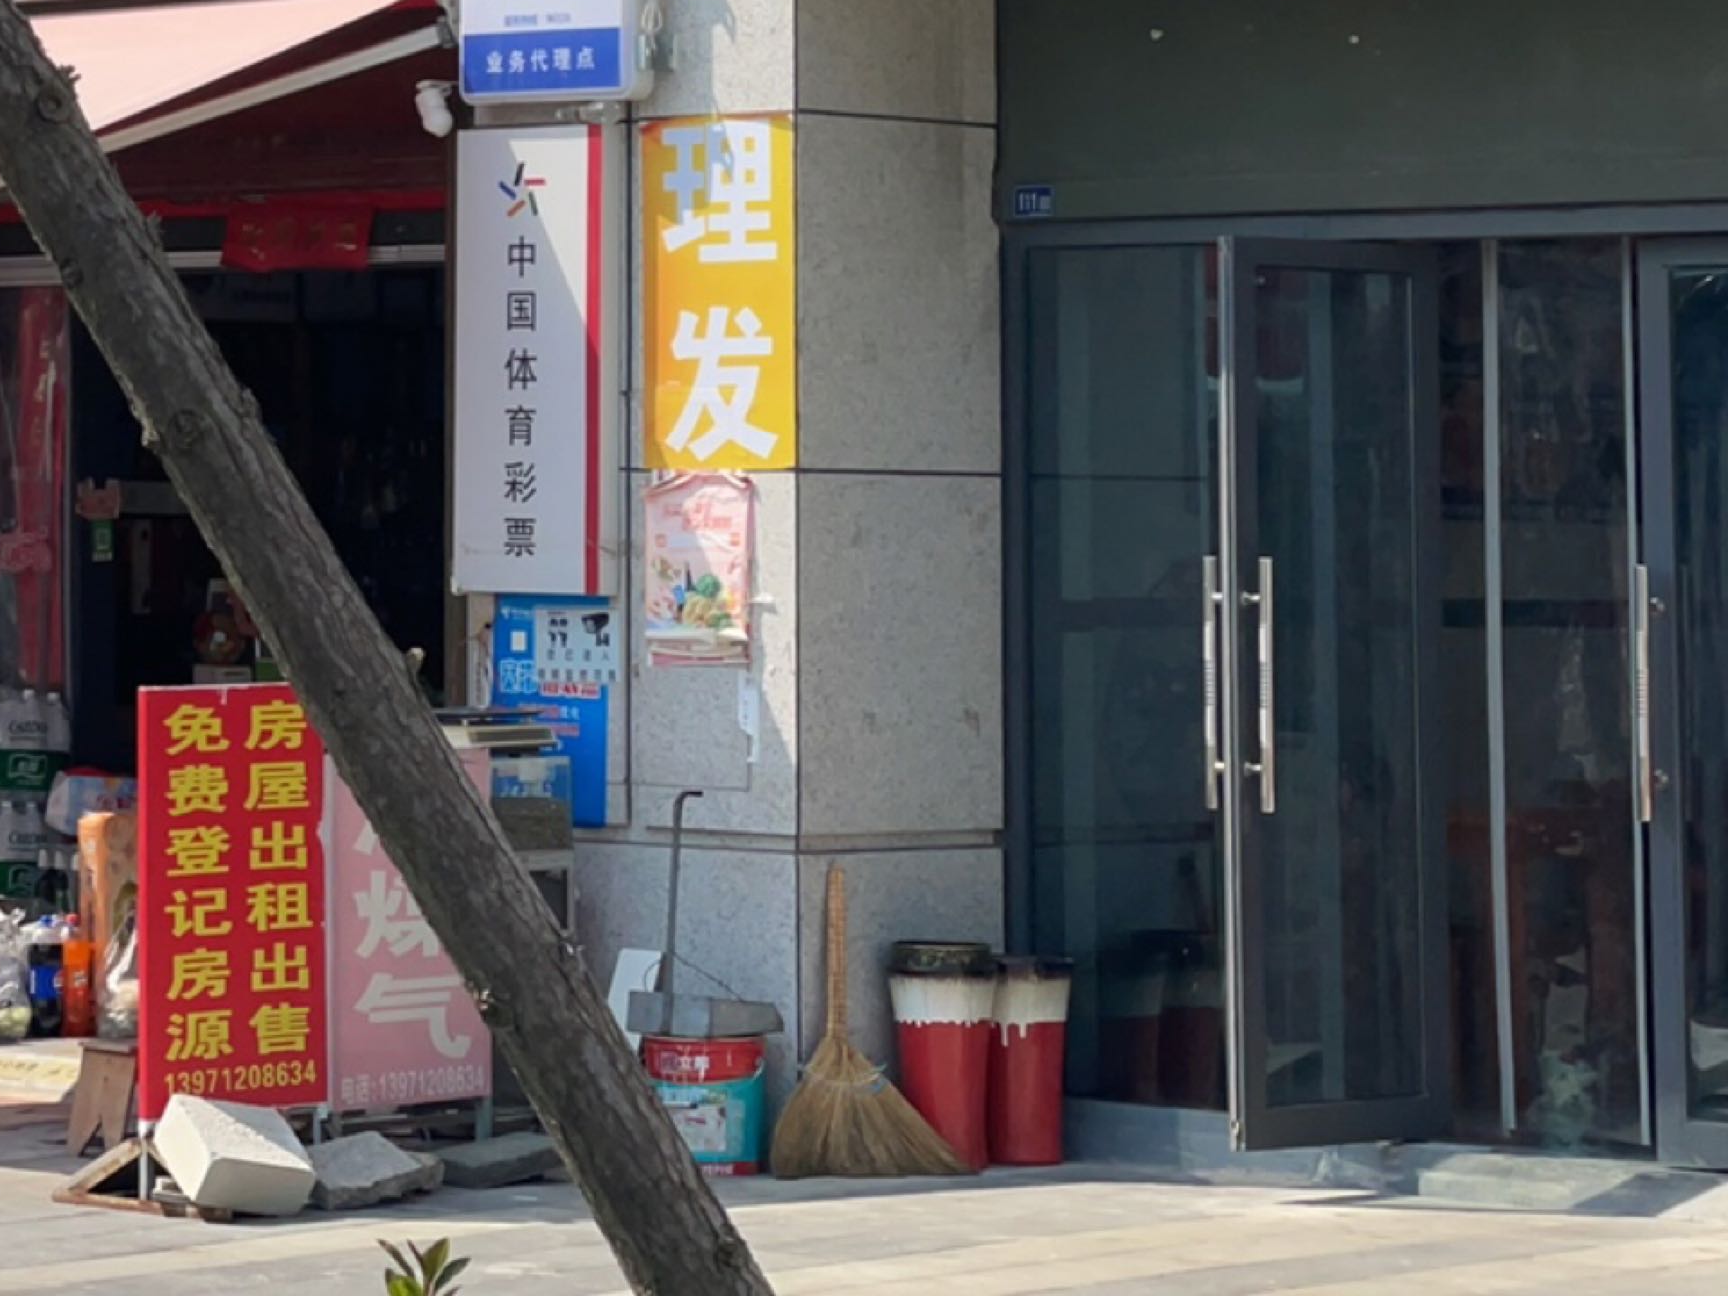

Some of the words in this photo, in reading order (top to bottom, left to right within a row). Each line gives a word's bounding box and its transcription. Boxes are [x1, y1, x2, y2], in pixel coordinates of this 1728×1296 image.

[486, 47, 595, 74] 业务代理点
[503, 235, 538, 557] 中国体育彩票
[660, 121, 779, 461] 理发
[164, 704, 234, 1062] 免费登记房源
[243, 700, 314, 1056] 房屋出租出售
[164, 1060, 317, 1096] 13971208634
